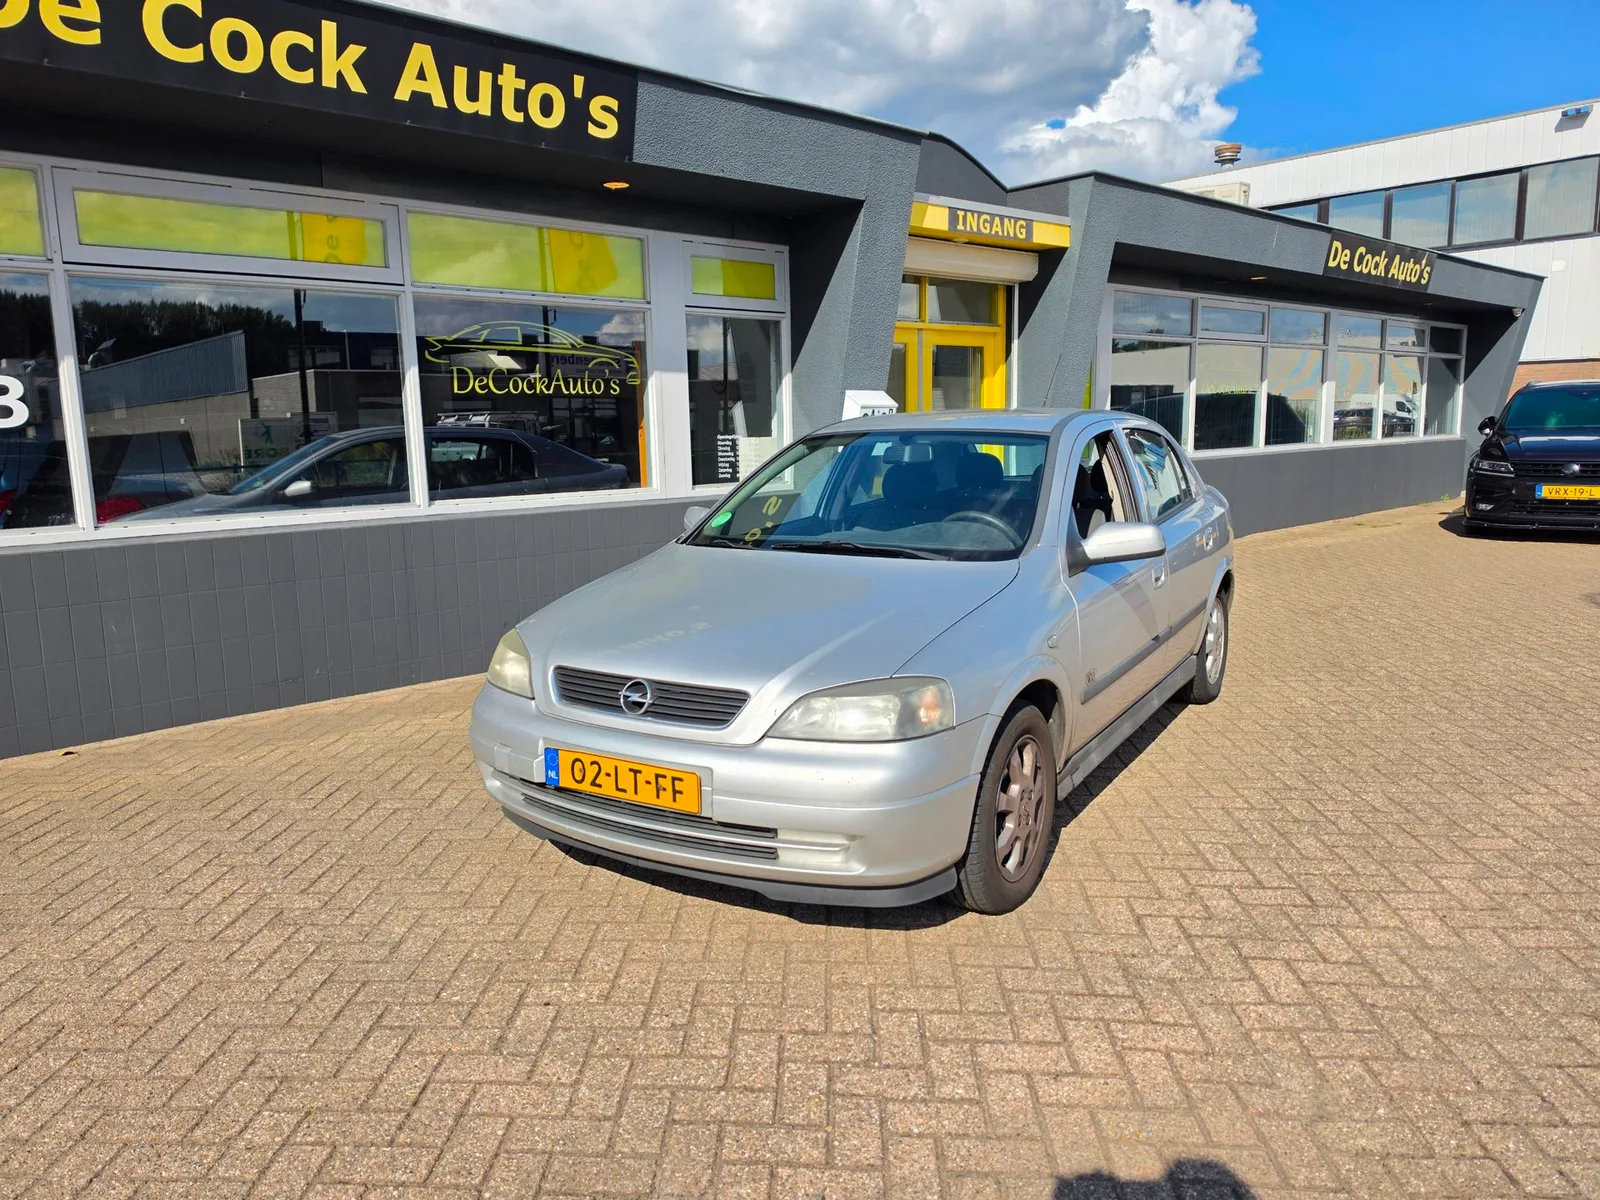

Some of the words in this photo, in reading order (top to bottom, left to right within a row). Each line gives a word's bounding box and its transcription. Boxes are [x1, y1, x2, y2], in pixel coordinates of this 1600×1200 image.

[0, 0, 101, 45] e
[142, 0, 368, 94] Cock
[394, 42, 620, 139] Auto's
[956, 210, 1027, 239] INGANG
[1327, 240, 1351, 270] De
[1353, 246, 1389, 277] Cock
[1388, 253, 1431, 285] Auto's
[1547, 487, 1596, 497] VRX-19-L
[548, 769, 559, 780] NL
[570, 757, 685, 804] 02-LT-FF
